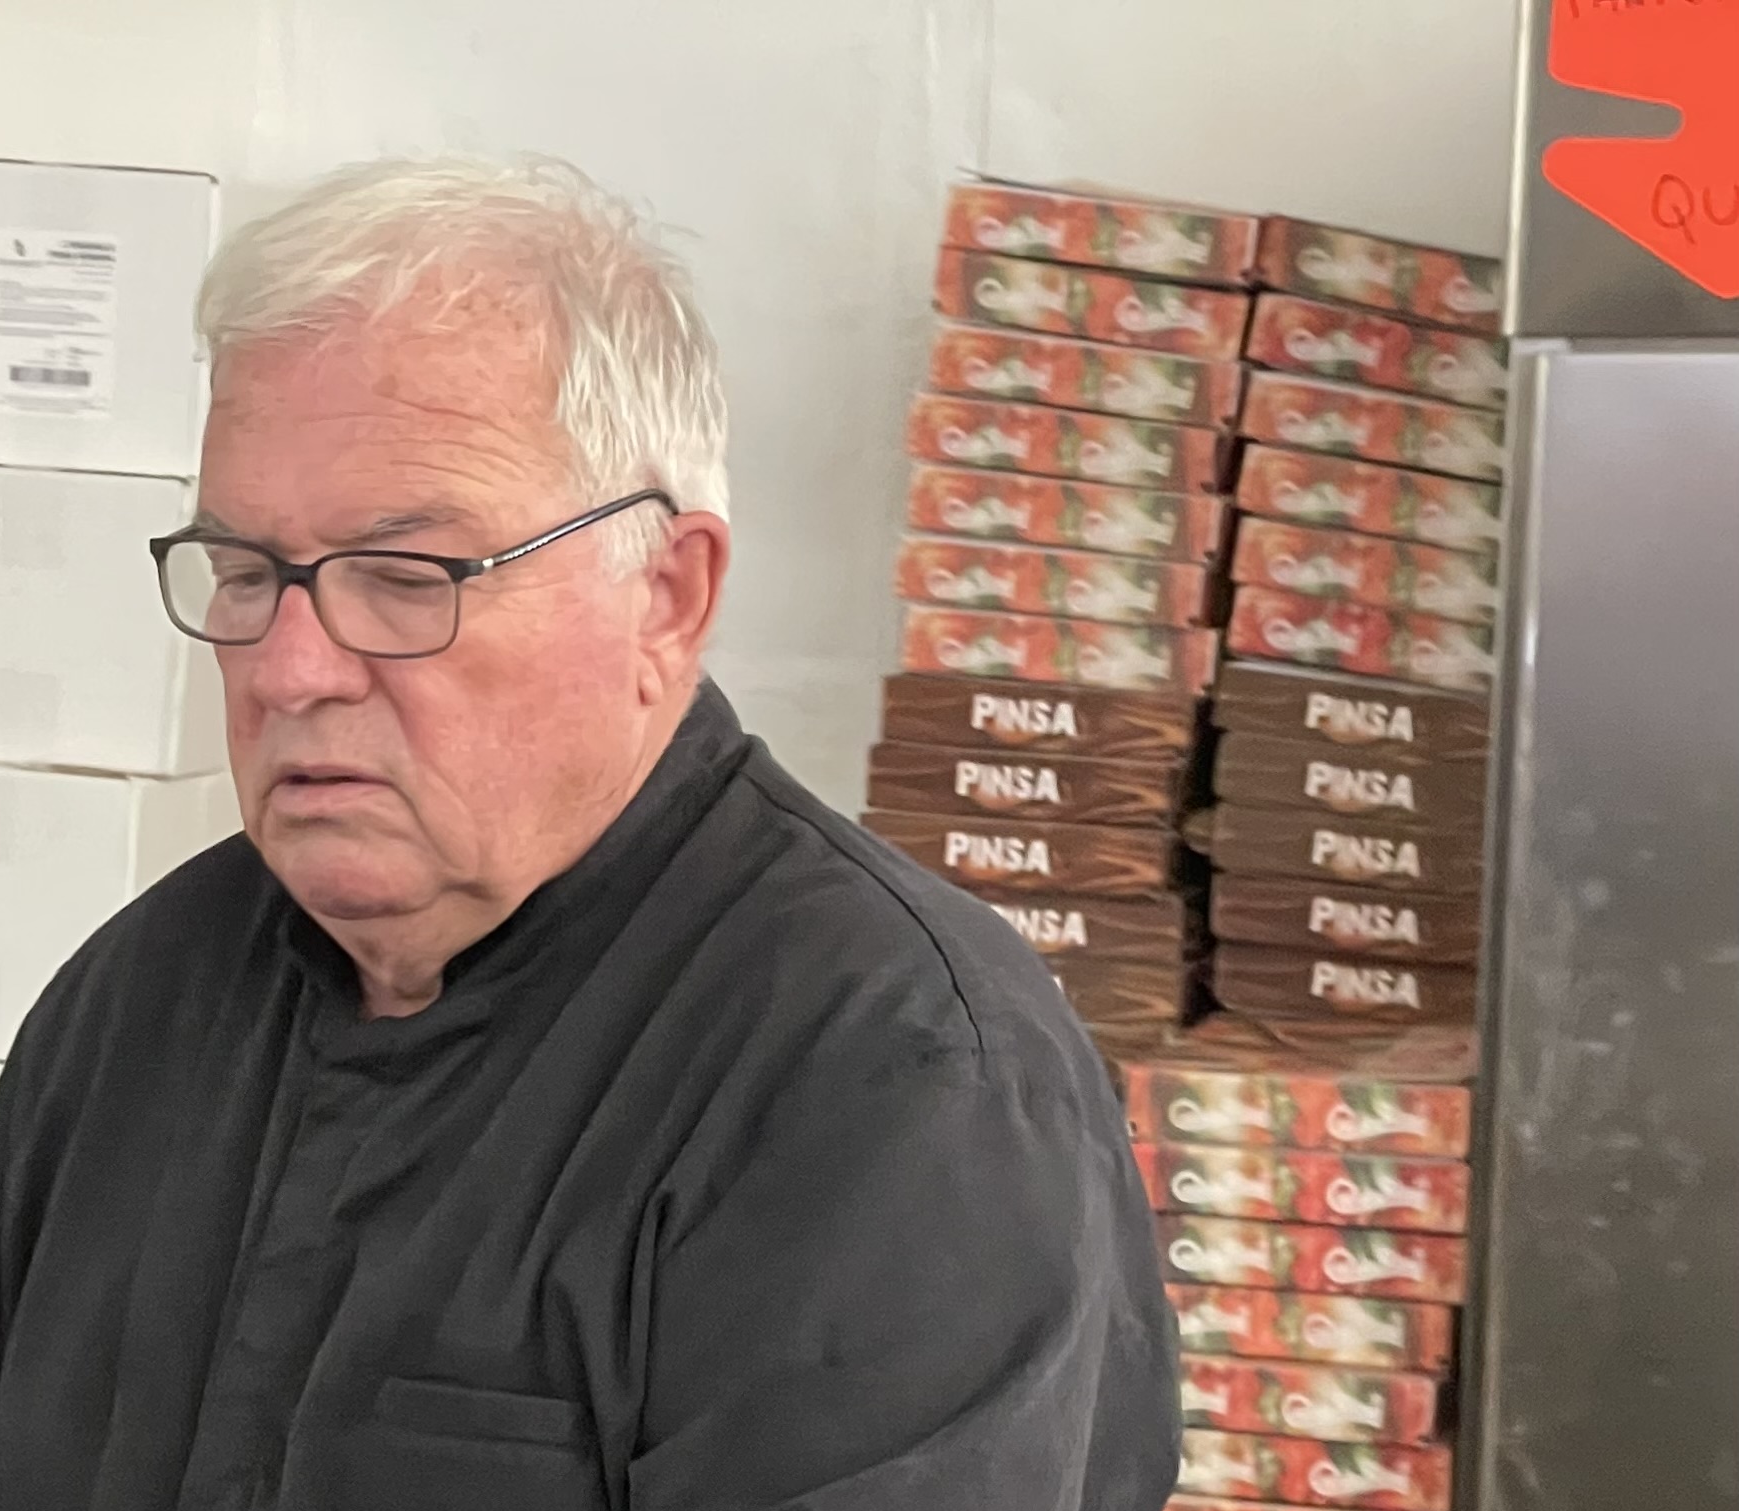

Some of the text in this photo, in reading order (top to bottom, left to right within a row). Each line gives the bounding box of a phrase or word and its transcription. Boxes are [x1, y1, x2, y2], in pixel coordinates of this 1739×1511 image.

[970, 693, 1078, 737] PINSA
[1305, 691, 1414, 742] PINSA
[955, 760, 1061, 804] PINSA
[1305, 761, 1416, 811] PINSA
[945, 831, 1051, 877] PINSA
[1312, 830, 1421, 877] PINSA
[1309, 897, 1420, 944] PINSA
[1311, 961, 1422, 1010] PINSA
